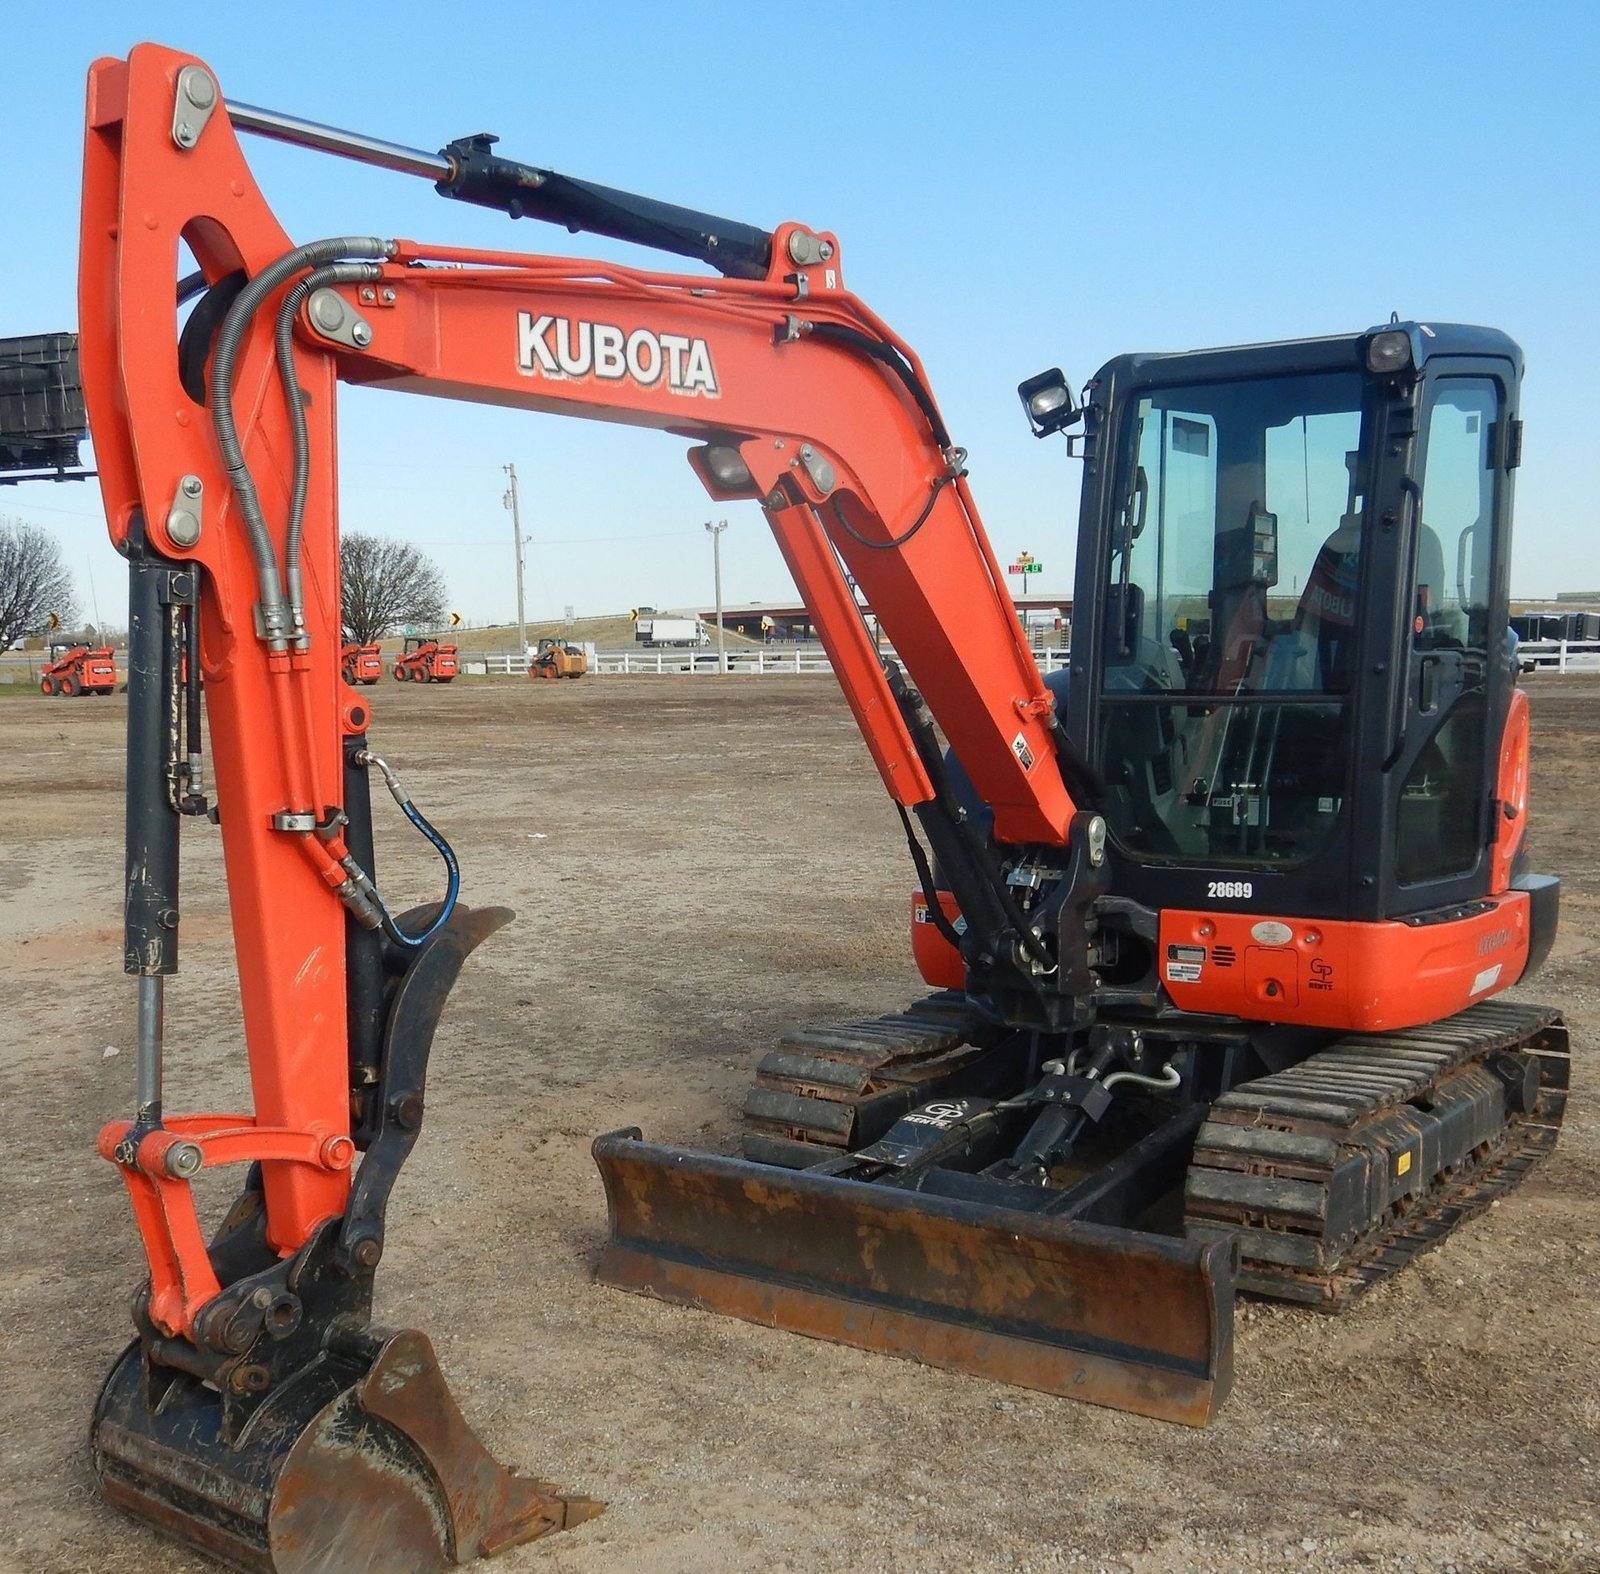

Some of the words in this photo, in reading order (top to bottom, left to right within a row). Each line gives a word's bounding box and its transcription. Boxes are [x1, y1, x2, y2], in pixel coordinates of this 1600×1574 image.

[517, 311, 718, 393] KUBOTA
[1207, 881, 1253, 898] 28689
[1308, 981, 1334, 991] RENTS
